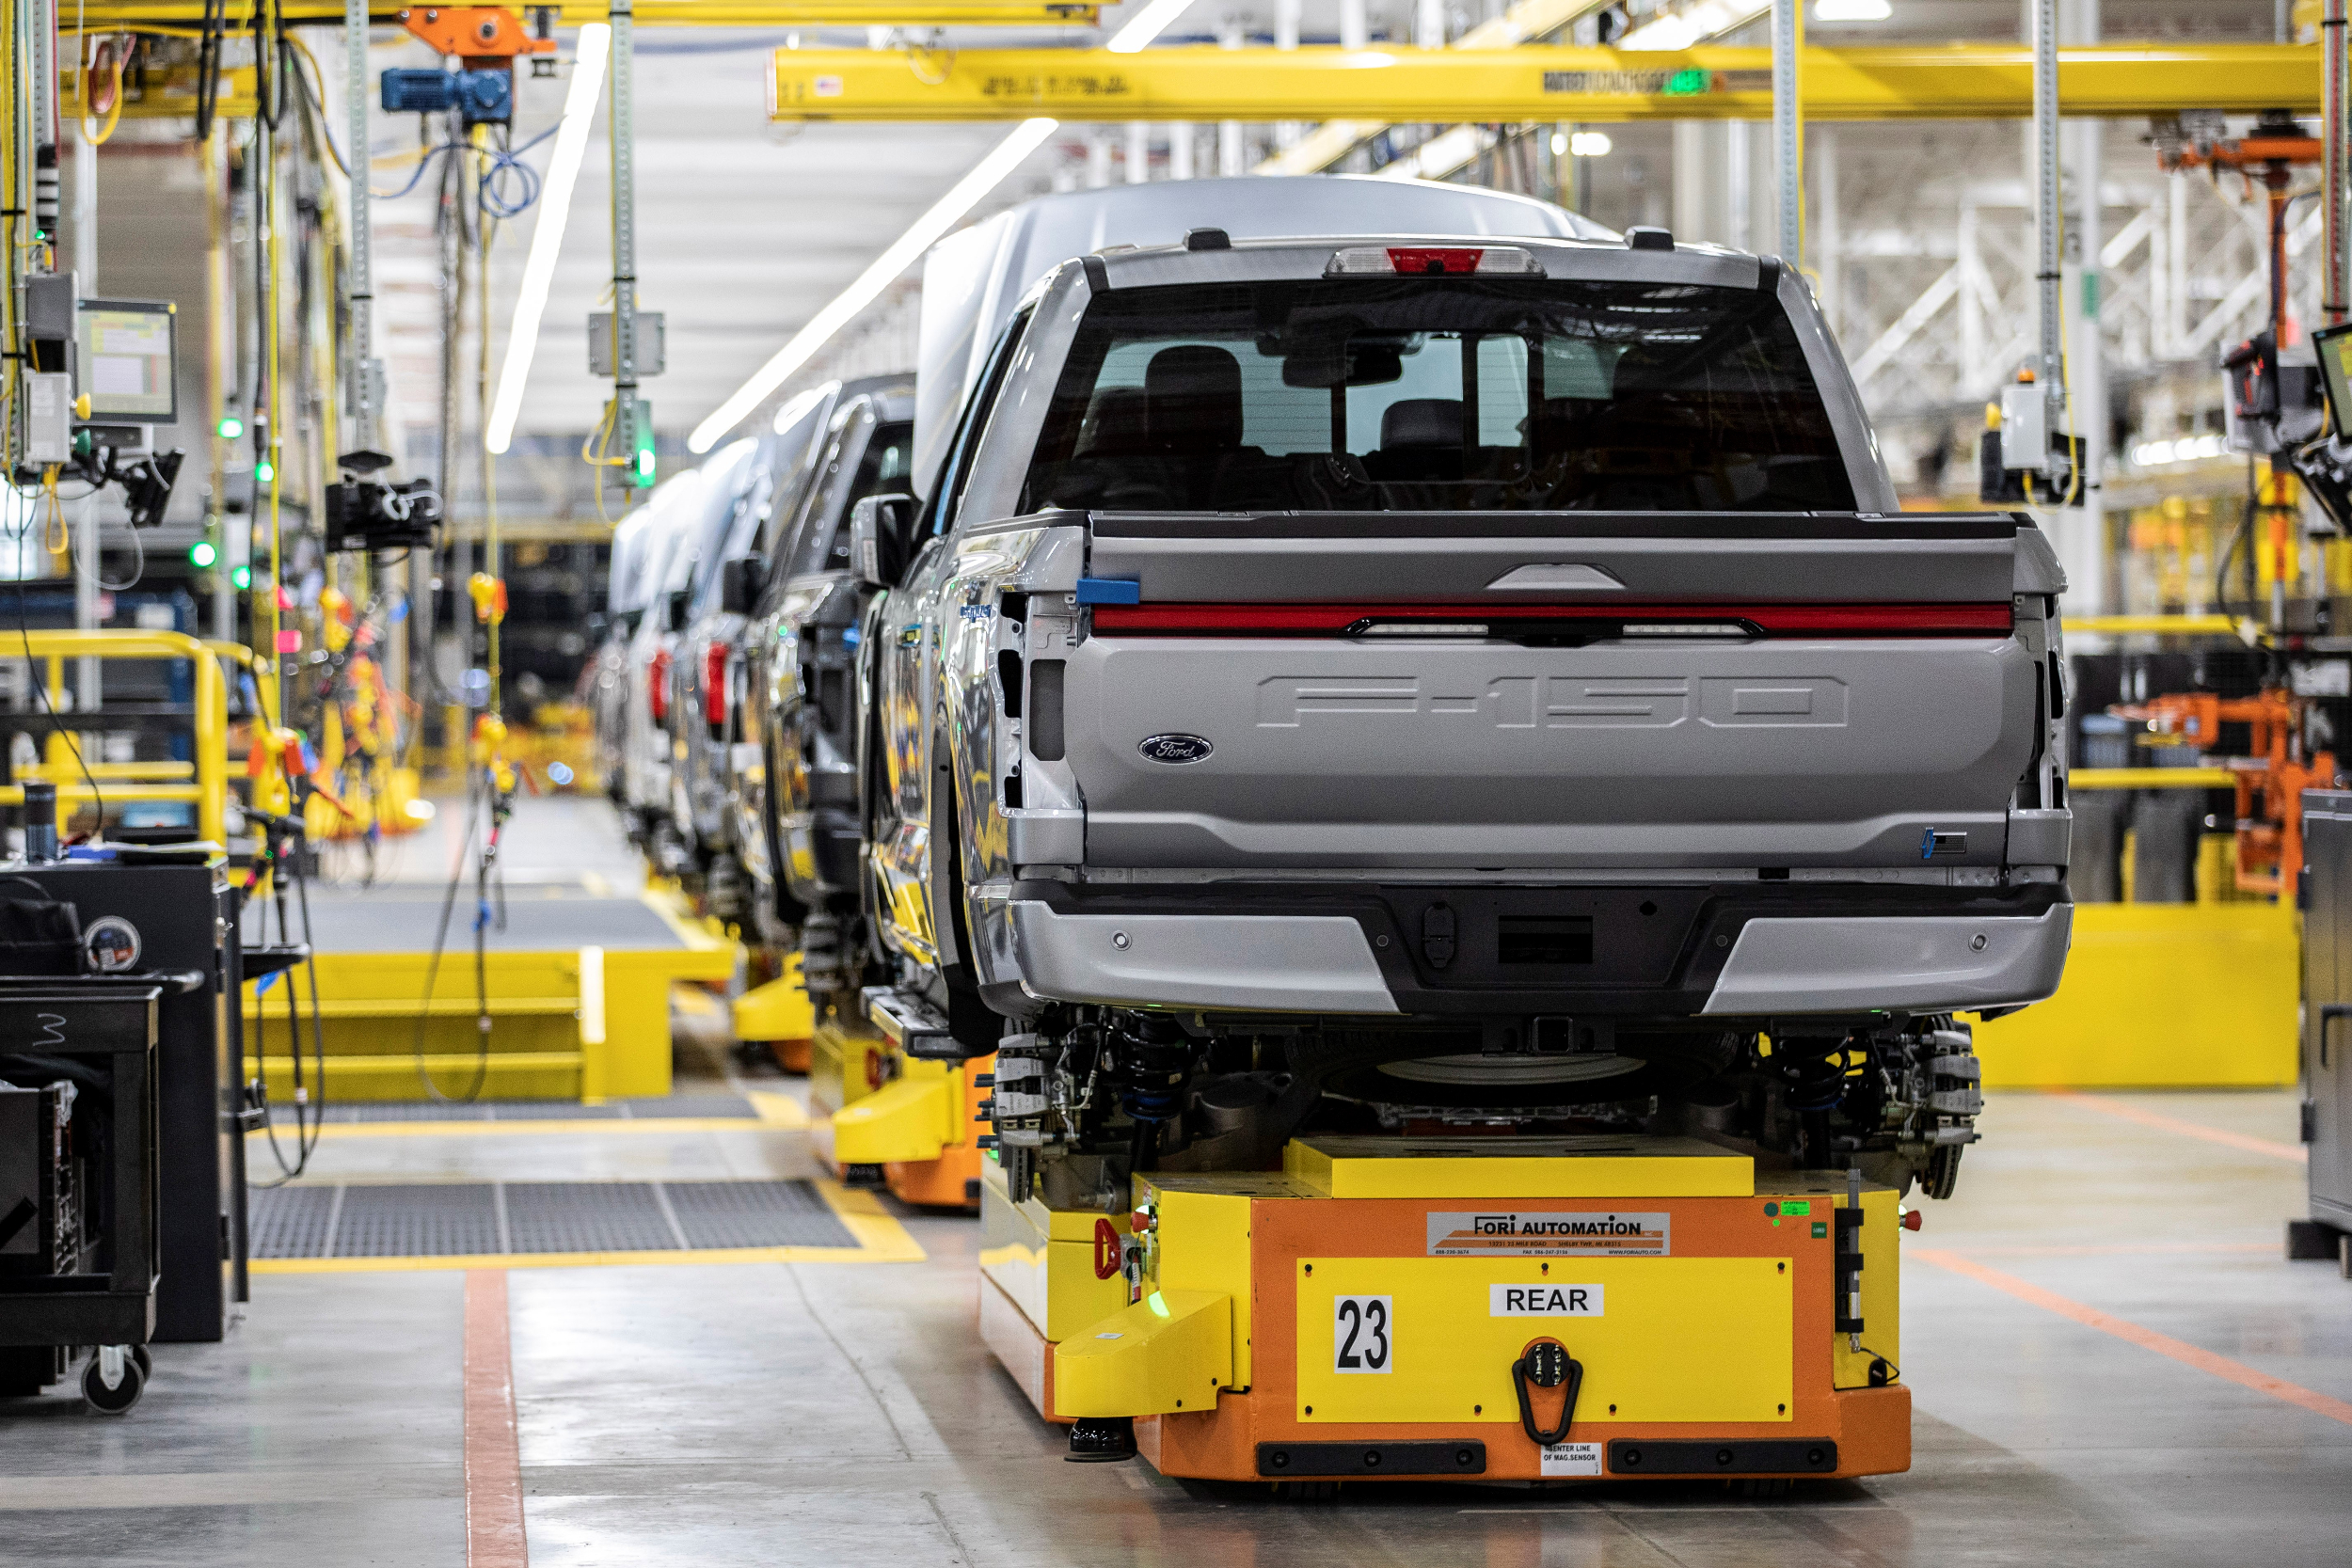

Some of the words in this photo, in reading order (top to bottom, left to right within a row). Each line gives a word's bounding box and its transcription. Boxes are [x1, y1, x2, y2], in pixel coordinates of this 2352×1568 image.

[1256, 675, 1850, 728] F-150
[1155, 740, 1196, 757] Ford
[1506, 1289, 1589, 1311] REAR
[1337, 1299, 1388, 1370] 23
